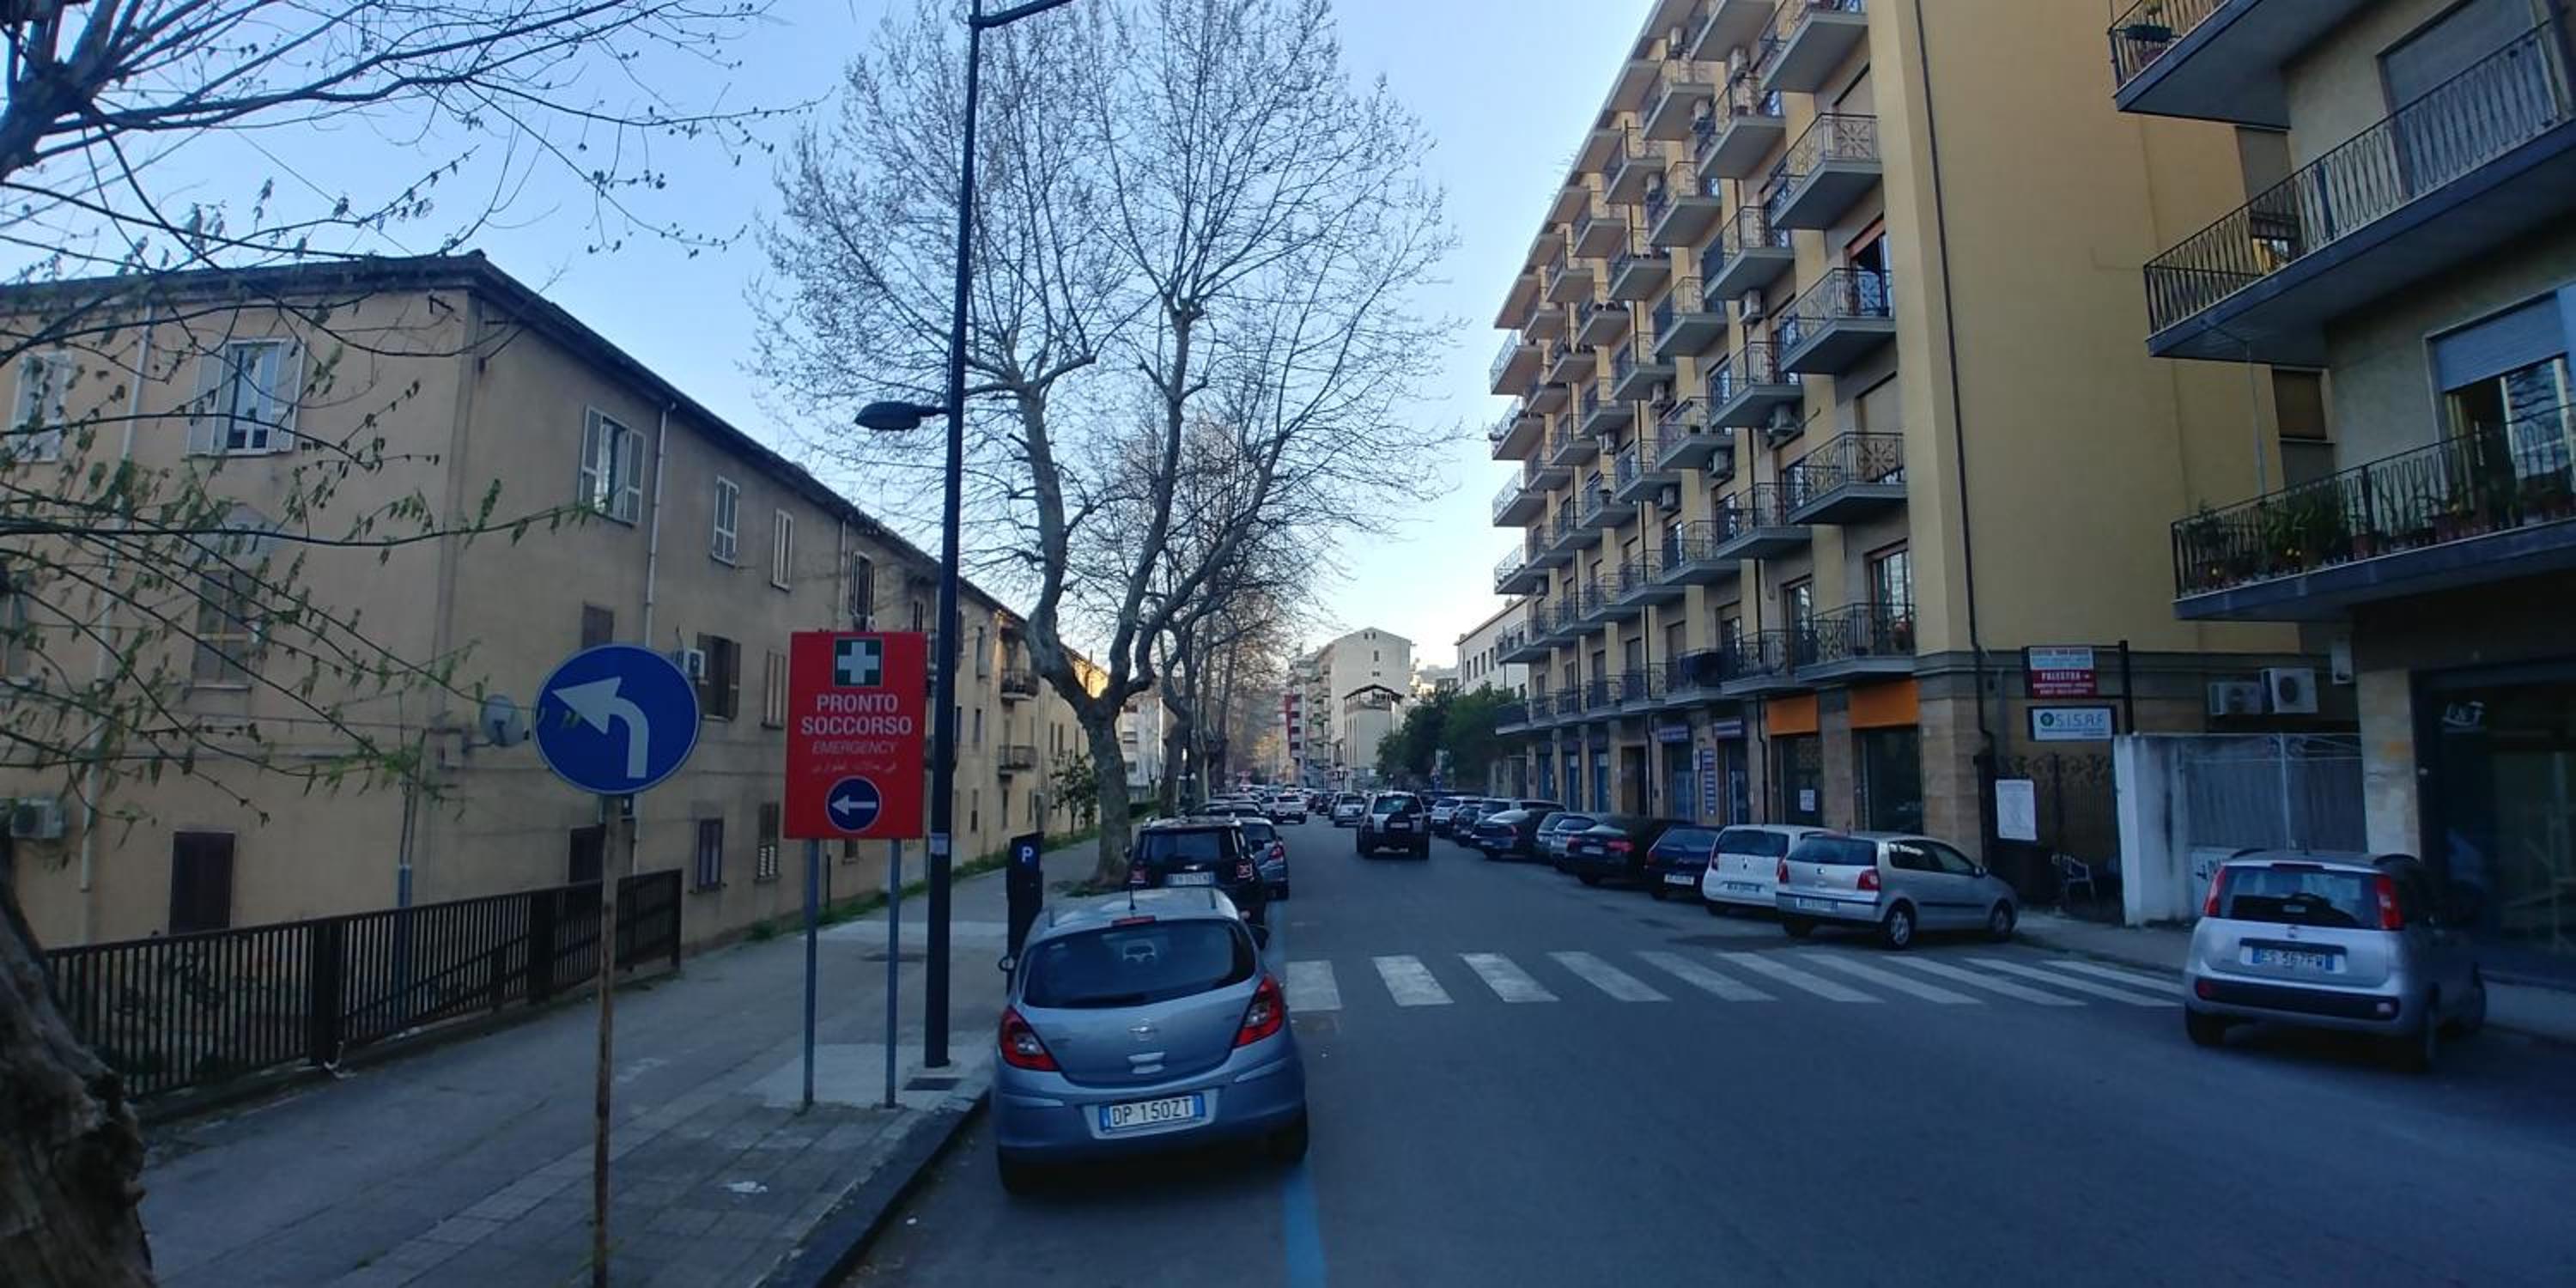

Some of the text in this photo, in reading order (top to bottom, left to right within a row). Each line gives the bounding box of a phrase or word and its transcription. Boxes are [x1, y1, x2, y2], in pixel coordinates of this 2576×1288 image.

[817, 693, 898, 714] PRONTO
[801, 716, 912, 735] SOCCORSO
[811, 741, 897, 755] EMERGENCY
[1022, 846, 1034, 863] P
[1112, 1098, 1191, 1125] DP 150ZT
